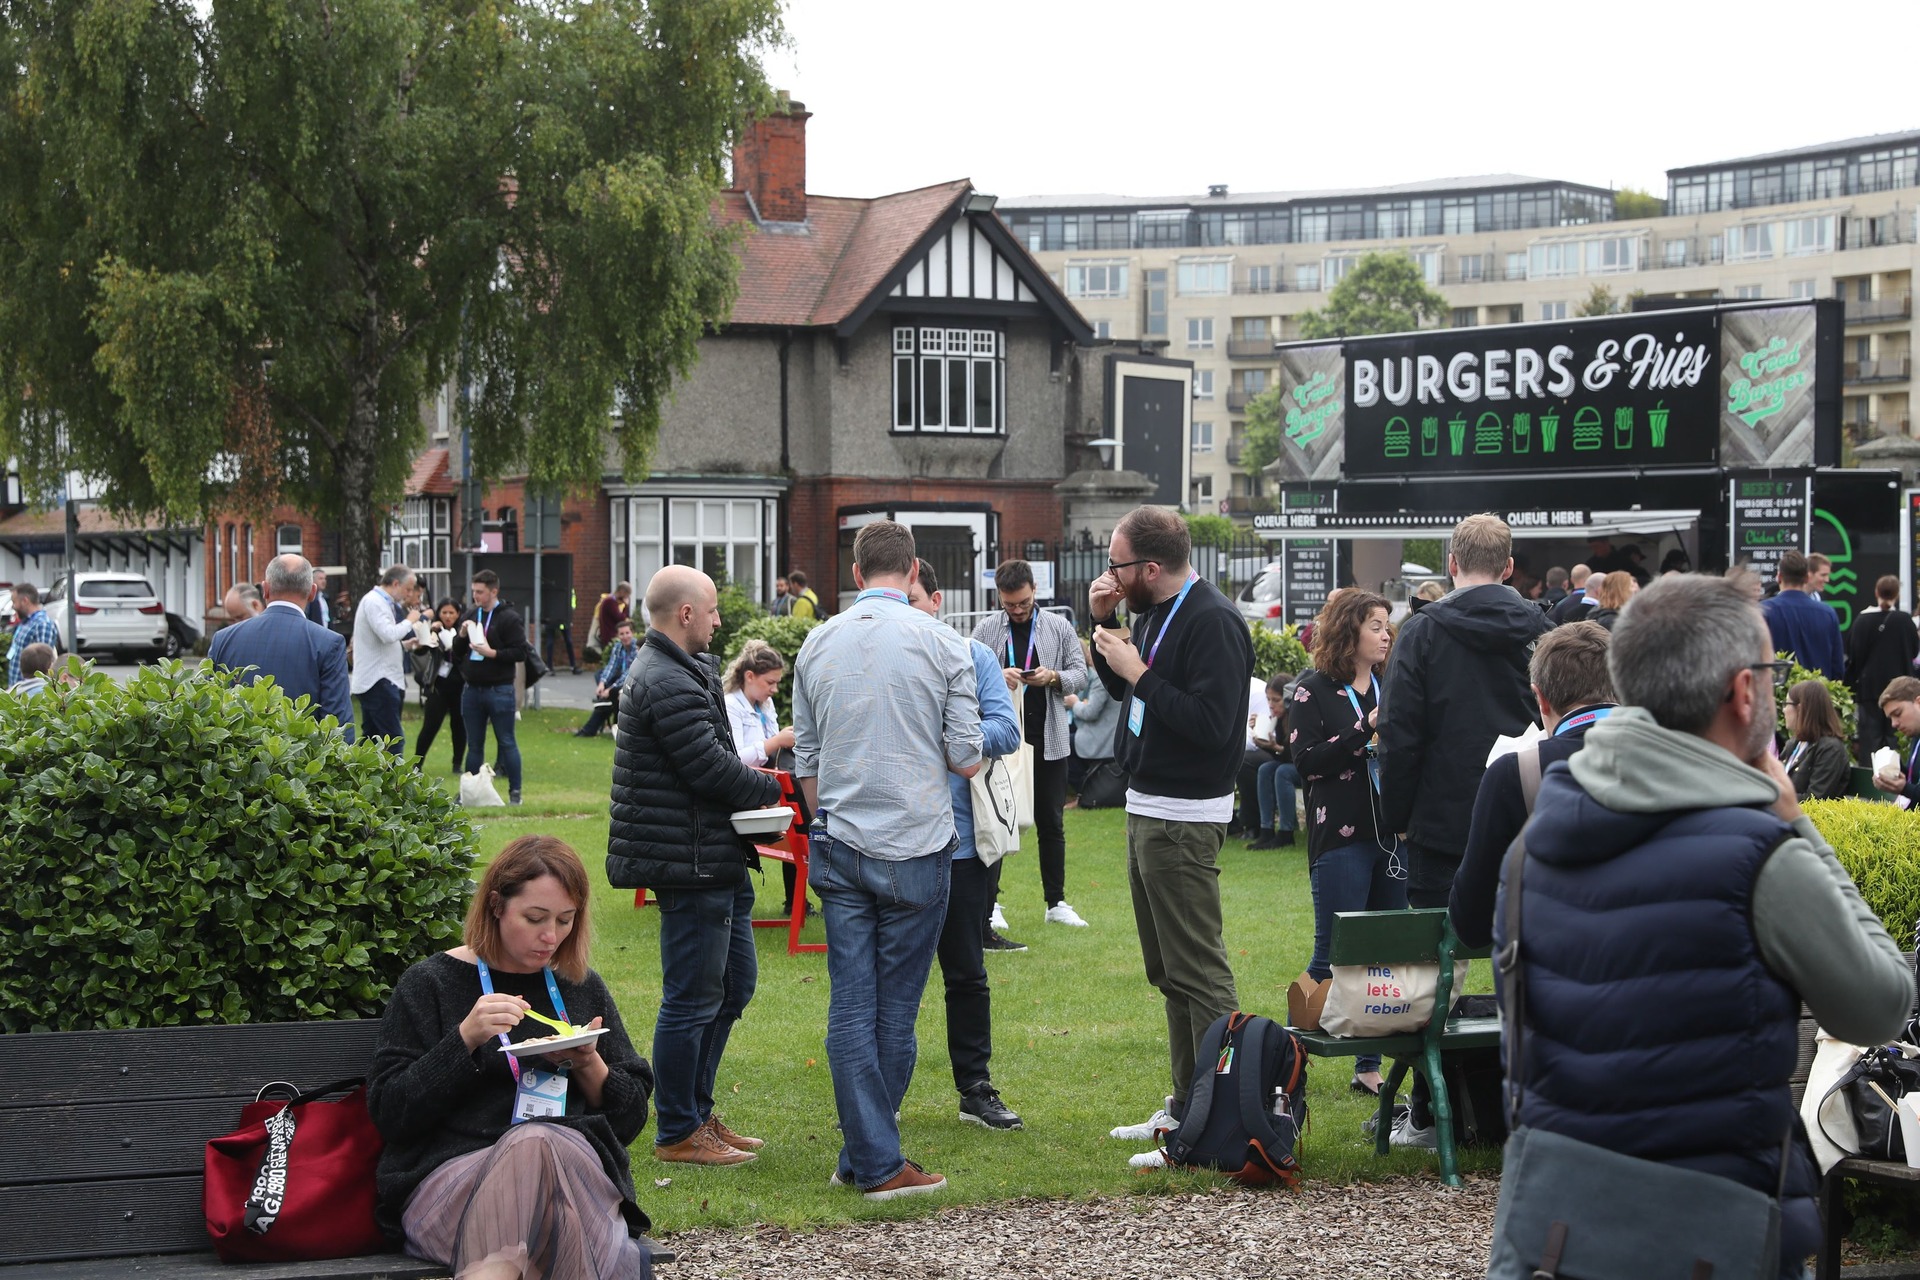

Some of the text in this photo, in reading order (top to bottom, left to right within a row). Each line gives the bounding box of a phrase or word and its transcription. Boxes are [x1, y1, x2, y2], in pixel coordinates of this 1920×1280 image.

[1740, 340, 1801, 379] Good
[1354, 332, 1711, 407] BURGERS & Fries
[1728, 371, 1805, 416] Burger
[1285, 401, 1339, 439] Burger
[1254, 515, 1317, 528] QUEUE HERE
[1507, 511, 1584, 525] QUEUE HERE
[1745, 530, 1775, 545] Chicken
[1367, 966, 1394, 979] me,
[1367, 983, 1401, 998] let's
[1365, 1003, 1411, 1014] rebel!
